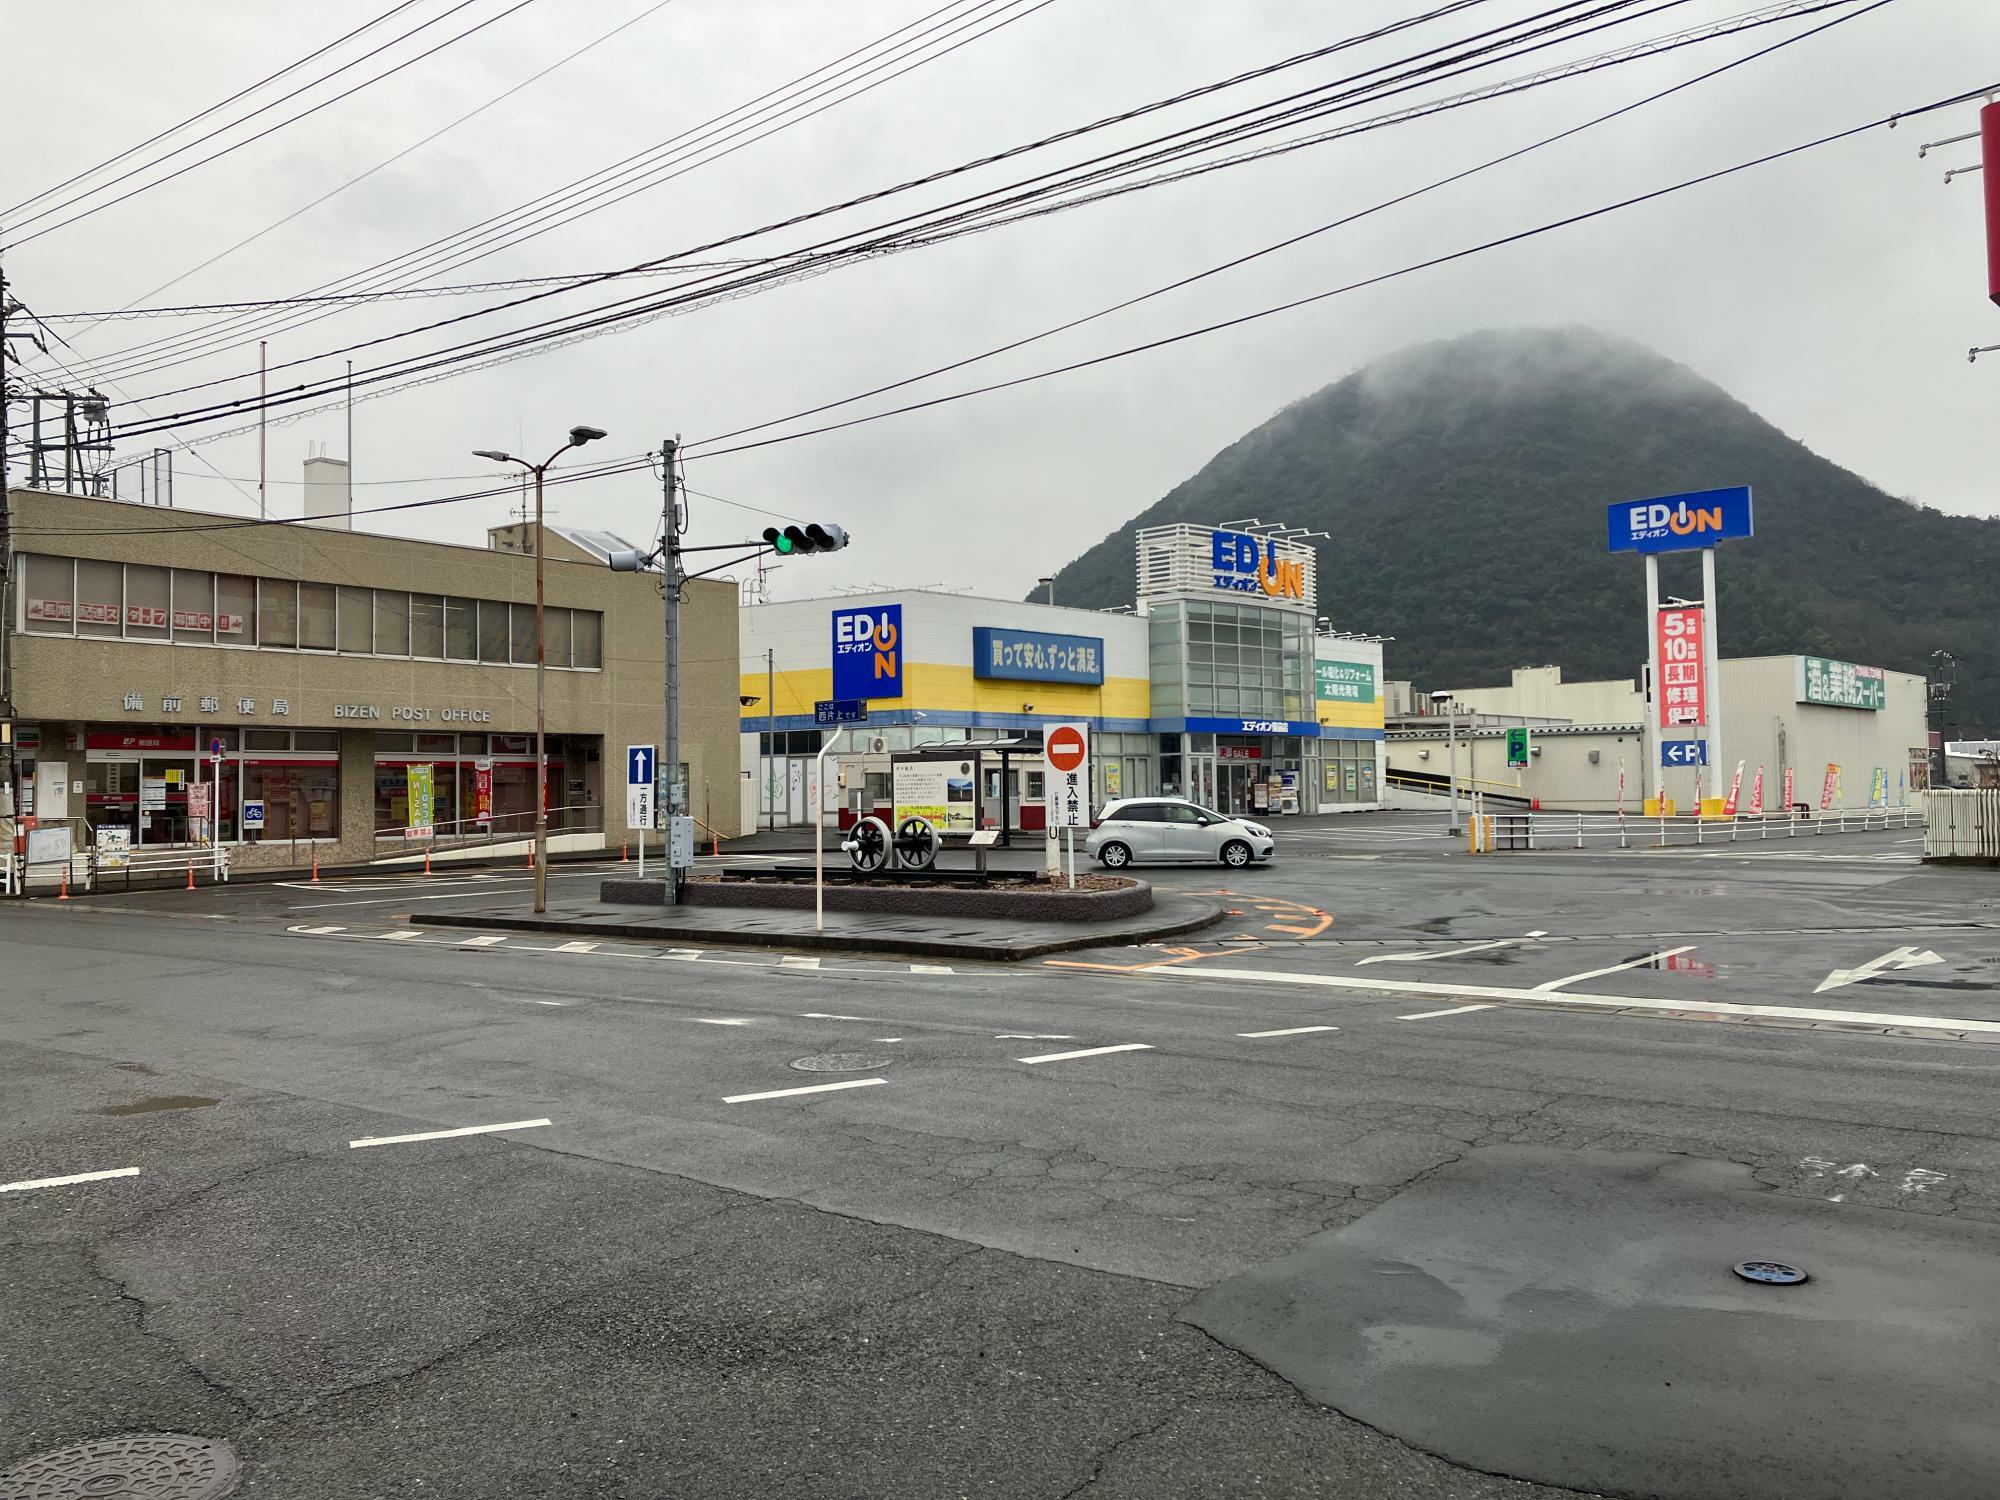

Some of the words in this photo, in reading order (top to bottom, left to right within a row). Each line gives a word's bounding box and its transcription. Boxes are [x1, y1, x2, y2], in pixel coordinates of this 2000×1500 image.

[1630, 501, 1722, 535] EDION
[1631, 528, 1668, 540] エディオン
[1212, 531, 1304, 599] EDION
[1214, 575, 1258, 592] エディオン
[837, 612, 897, 679] EDION
[837, 642, 872, 654] エディオン
[992, 640, 1099, 673] 買って安心、ずっと満足。
[1668, 665, 1695, 682] 長期
[1325, 683, 1359, 697] 太陽光発電
[1667, 686, 1698, 704] 修理
[122, 692, 289, 716] 備前郵便局
[333, 705, 380, 718] BIZEN
[392, 707, 432, 720] POST
[441, 709, 491, 723] OFFICE
[1233, 750, 1249, 758] SALE
[1511, 742, 1524, 758] P
[639, 787, 648, 826] 一方通行
[1066, 773, 1079, 826] 進入禁止
